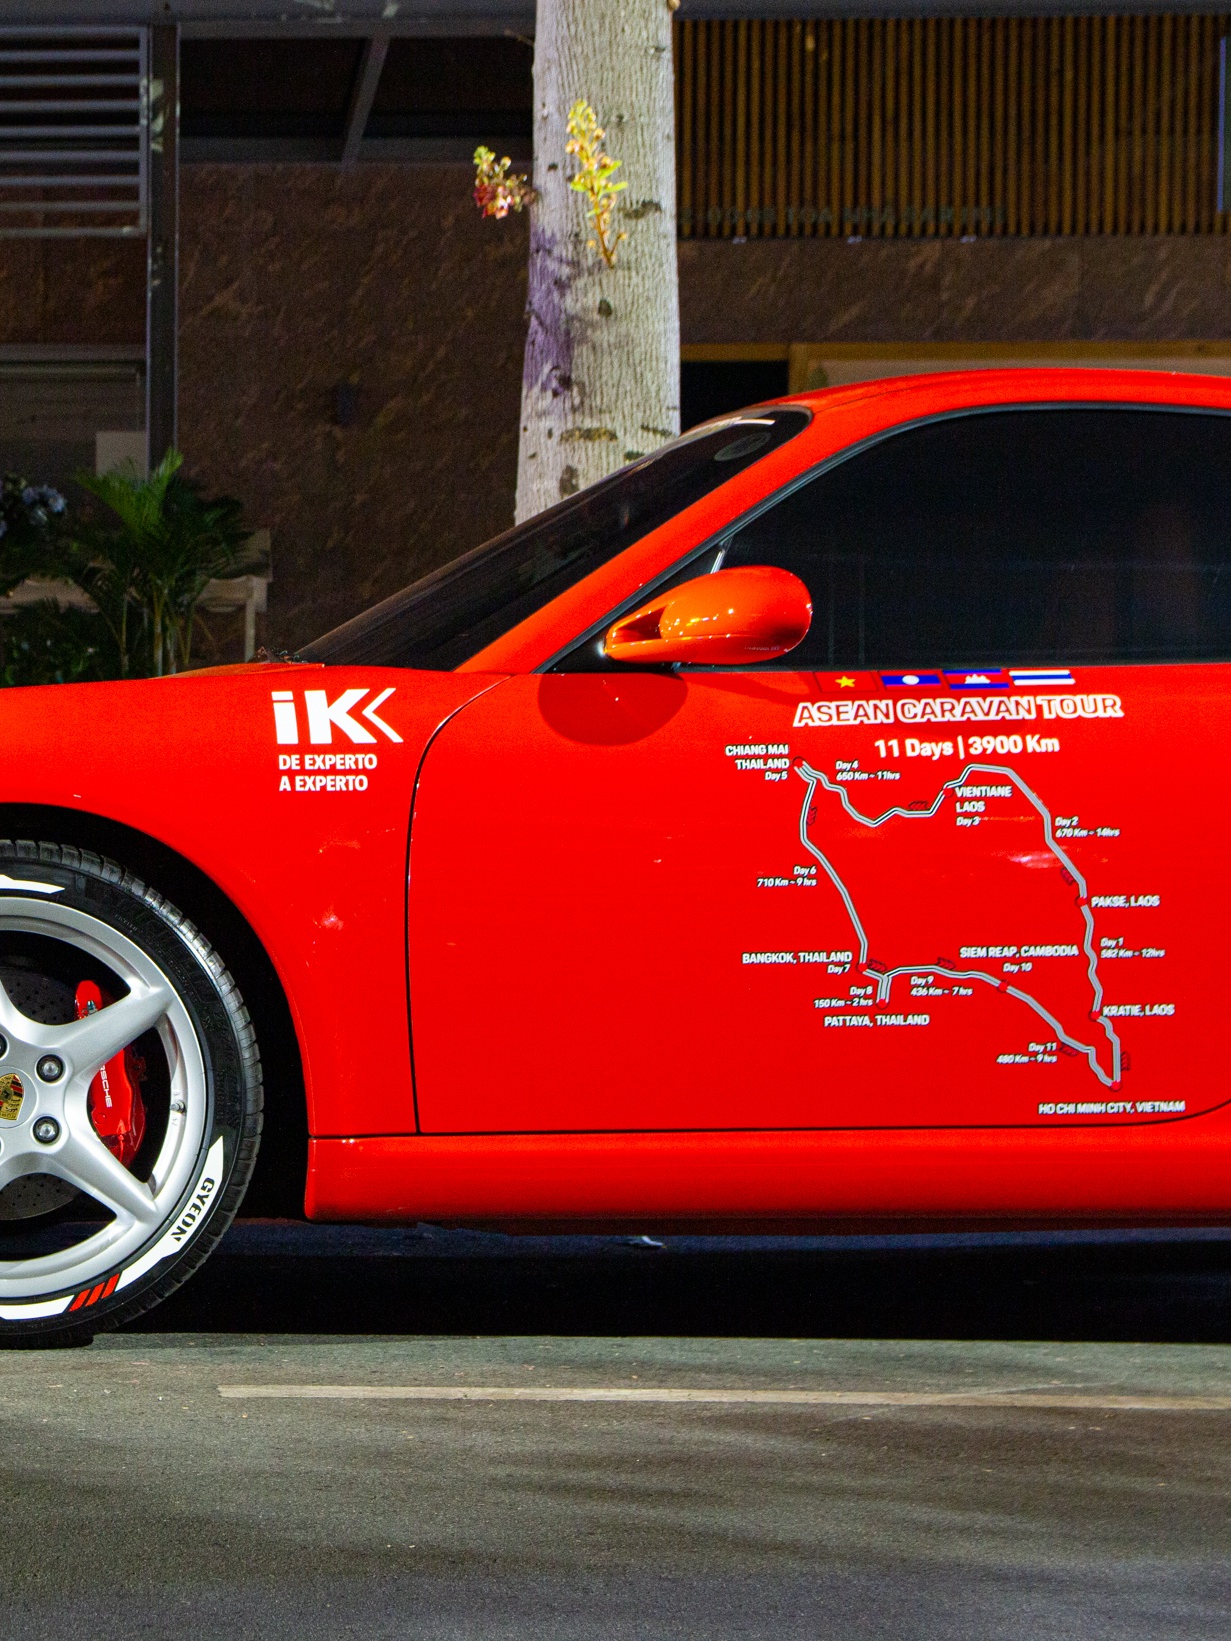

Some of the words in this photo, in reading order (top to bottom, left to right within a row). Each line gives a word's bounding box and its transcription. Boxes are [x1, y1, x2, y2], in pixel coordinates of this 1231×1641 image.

[793, 700, 895, 727] ASEAN
[896, 696, 1037, 724] CARAVAN
[1036, 694, 1125, 719] TOUR
[725, 745, 767, 756] CHIANG
[767, 744, 789, 755] MAI
[875, 739, 900, 758] 11
[905, 738, 953, 761] Days
[968, 735, 1023, 755] 3900
[1026, 734, 1060, 753] Km
[279, 754, 300, 770] DE
[304, 754, 378, 770] EXPERTO
[735, 759, 790, 770] THAILAND
[835, 760, 852, 771] Day
[851, 760, 859, 769] 4
[765, 772, 781, 782] Day
[781, 771, 788, 780] 5
[836, 771, 854, 781] 650
[854, 771, 868, 780] Km
[279, 776, 291, 792] A
[295, 775, 368, 792] EXPERTO
[956, 786, 1012, 798] VIENTIANE
[956, 801, 985, 813] LAOS
[956, 816, 972, 827] Day
[1055, 816, 1071, 828] Day
[1071, 815, 1079, 826] 2
[1073, 827, 1088, 837] Km
[794, 866, 810, 876] Day
[810, 865, 817, 875] 6
[757, 878, 774, 887] 710
[775, 877, 789, 887] Km
[796, 877, 803, 886] 9
[803, 877, 817, 887] hrs
[1091, 896, 1129, 908] PAKSE,
[1130, 895, 1160, 907] LAOS
[1100, 937, 1117, 948] Day
[960, 946, 988, 958] SIEM
[988, 946, 1018, 958] REAP,
[1020, 945, 1079, 957] CAMBODIA
[742, 953, 797, 965] BANGKOK,
[798, 951, 852, 963] THAILAND
[827, 965, 844, 975] Day
[843, 964, 850, 973] 7
[1003, 963, 1019, 974] Day
[1019, 962, 1032, 972] 10
[911, 976, 927, 986] Day
[850, 987, 866, 997] Day
[928, 987, 943, 996] Km
[959, 986, 973, 996] hrs
[814, 999, 831, 1008] 150
[831, 998, 845, 1008] Km
[852, 998, 860, 1007] 2
[859, 998, 873, 1007] hrs
[1103, 1005, 1144, 1017] KRATIE,
[1145, 1004, 1175, 1016] LAOS
[824, 1016, 873, 1028] PATTAYA,
[875, 1014, 930, 1026] THAILAND
[1028, 1042, 1045, 1053] Day
[1045, 1042, 1057, 1051] 11
[1014, 1054, 1029, 1063] Km
[1043, 1053, 1057, 1063] hrs
[1038, 1103, 1056, 1114] HO
[1056, 1103, 1076, 1114] CHI
[1076, 1102, 1107, 1114] MINH
[1106, 1101, 1135, 1114] CITY,
[1135, 1100, 1186, 1112] VIETNAM
[171, 1177, 215, 1243] GYEON
